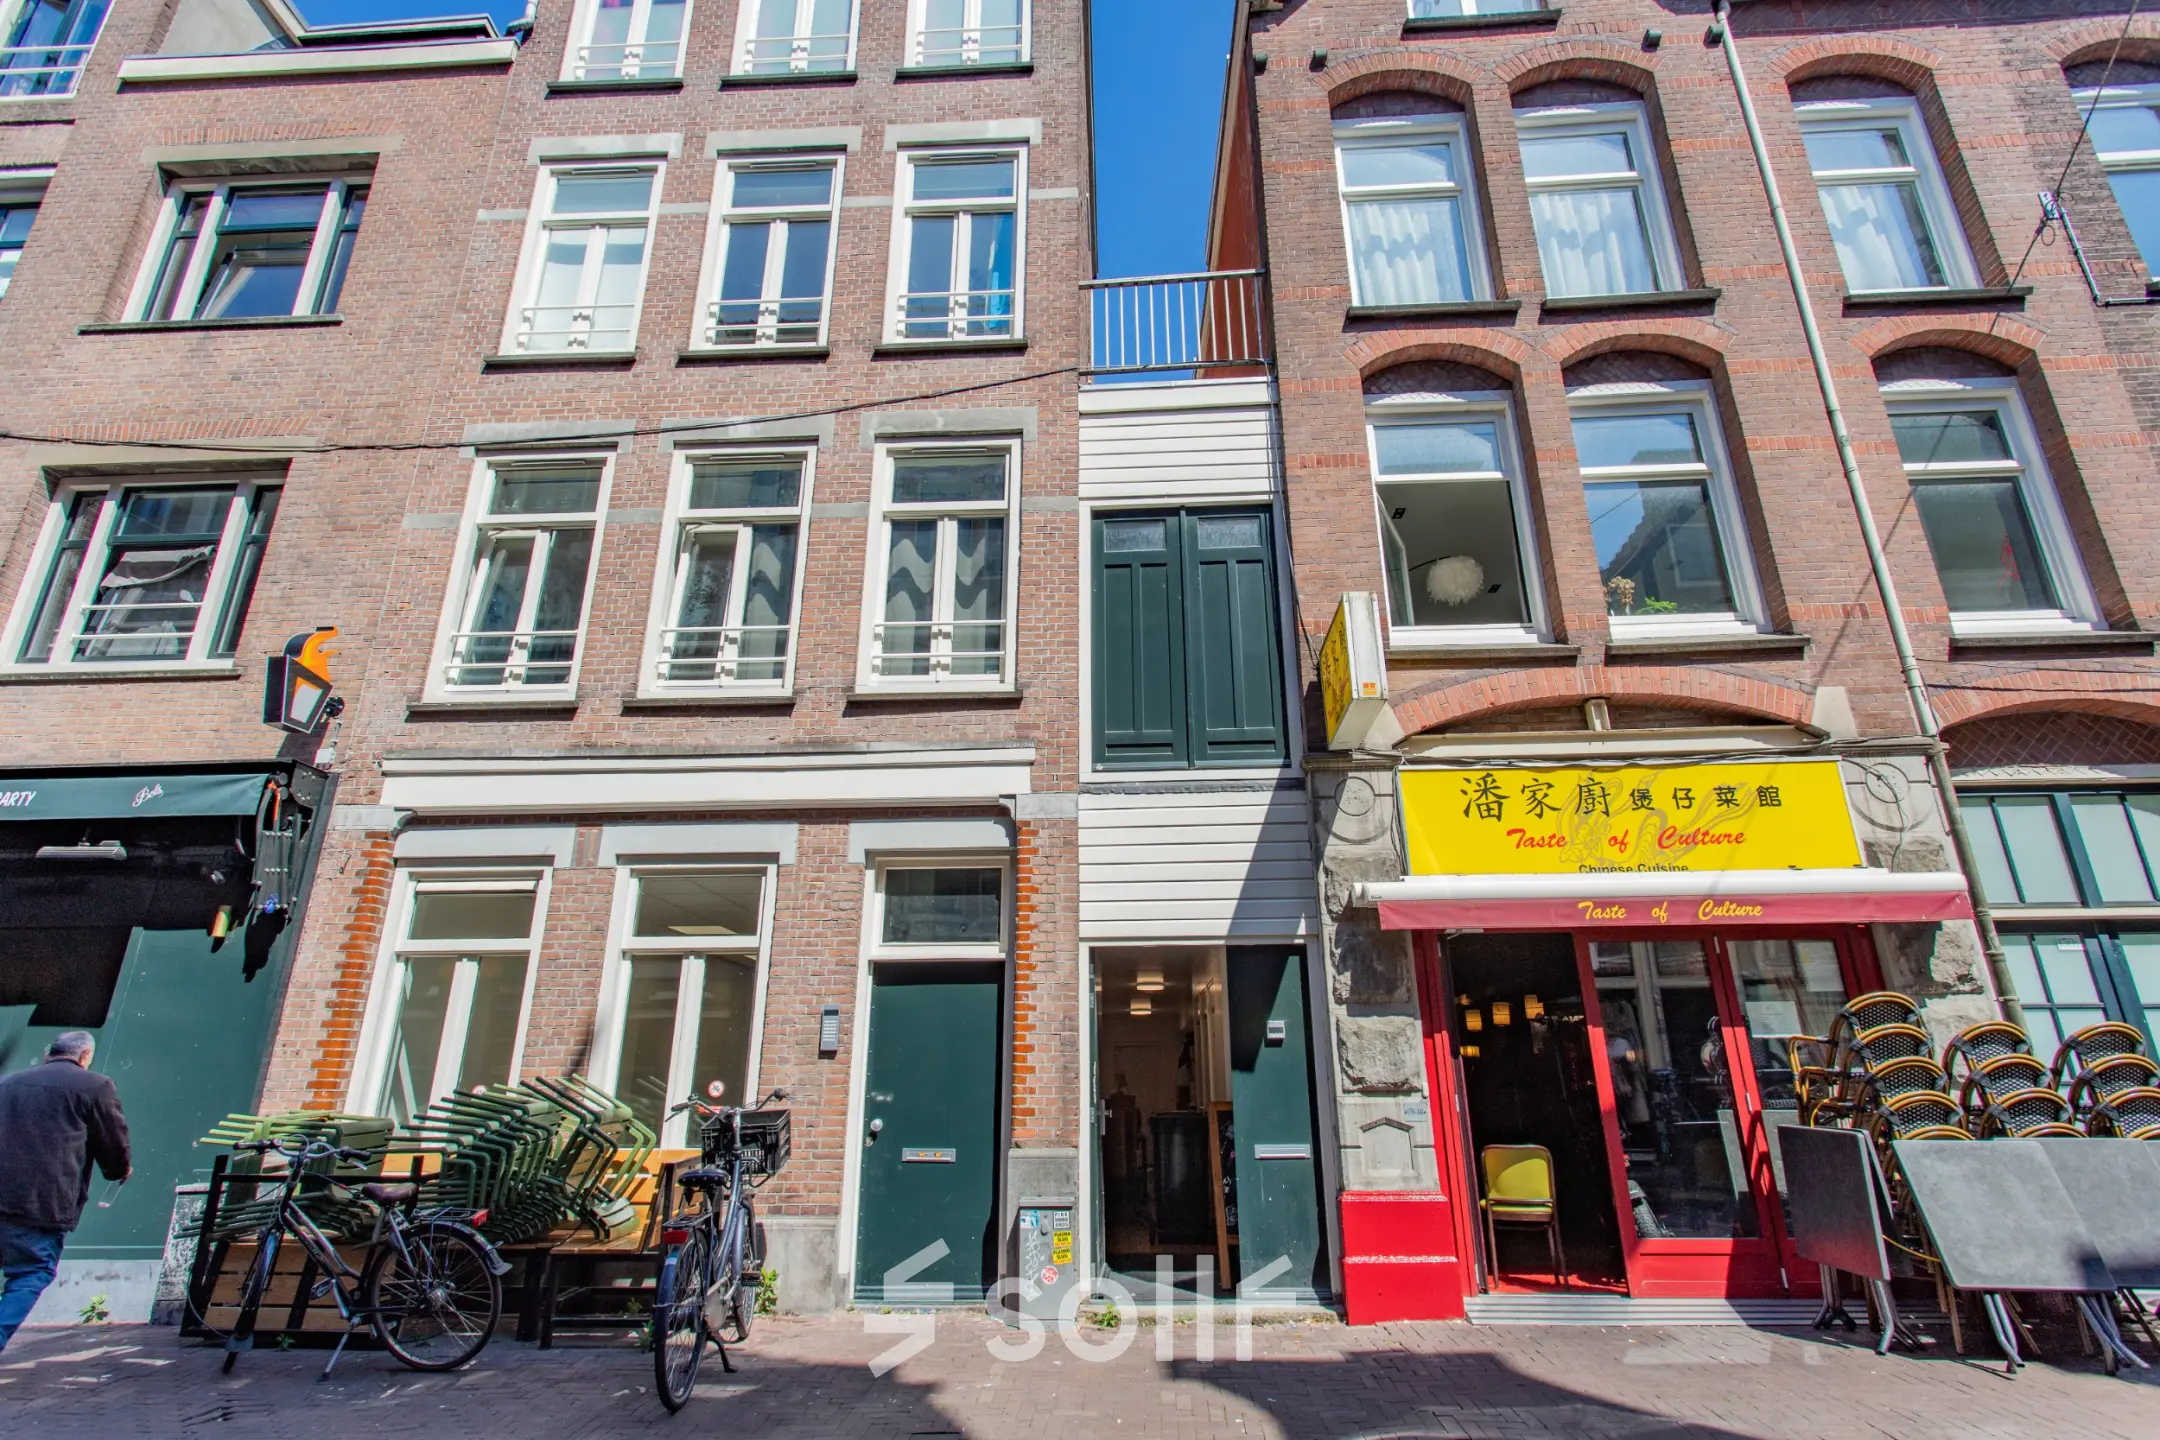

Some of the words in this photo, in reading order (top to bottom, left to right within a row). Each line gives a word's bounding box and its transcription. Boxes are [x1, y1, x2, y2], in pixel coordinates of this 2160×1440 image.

[1506, 828, 1566, 848] Taste
[1608, 829, 1630, 853] of
[1657, 826, 1746, 849] Culture
[1577, 900, 1627, 920] Taste
[1650, 901, 1668, 923] of
[1697, 899, 1764, 920] Culture
